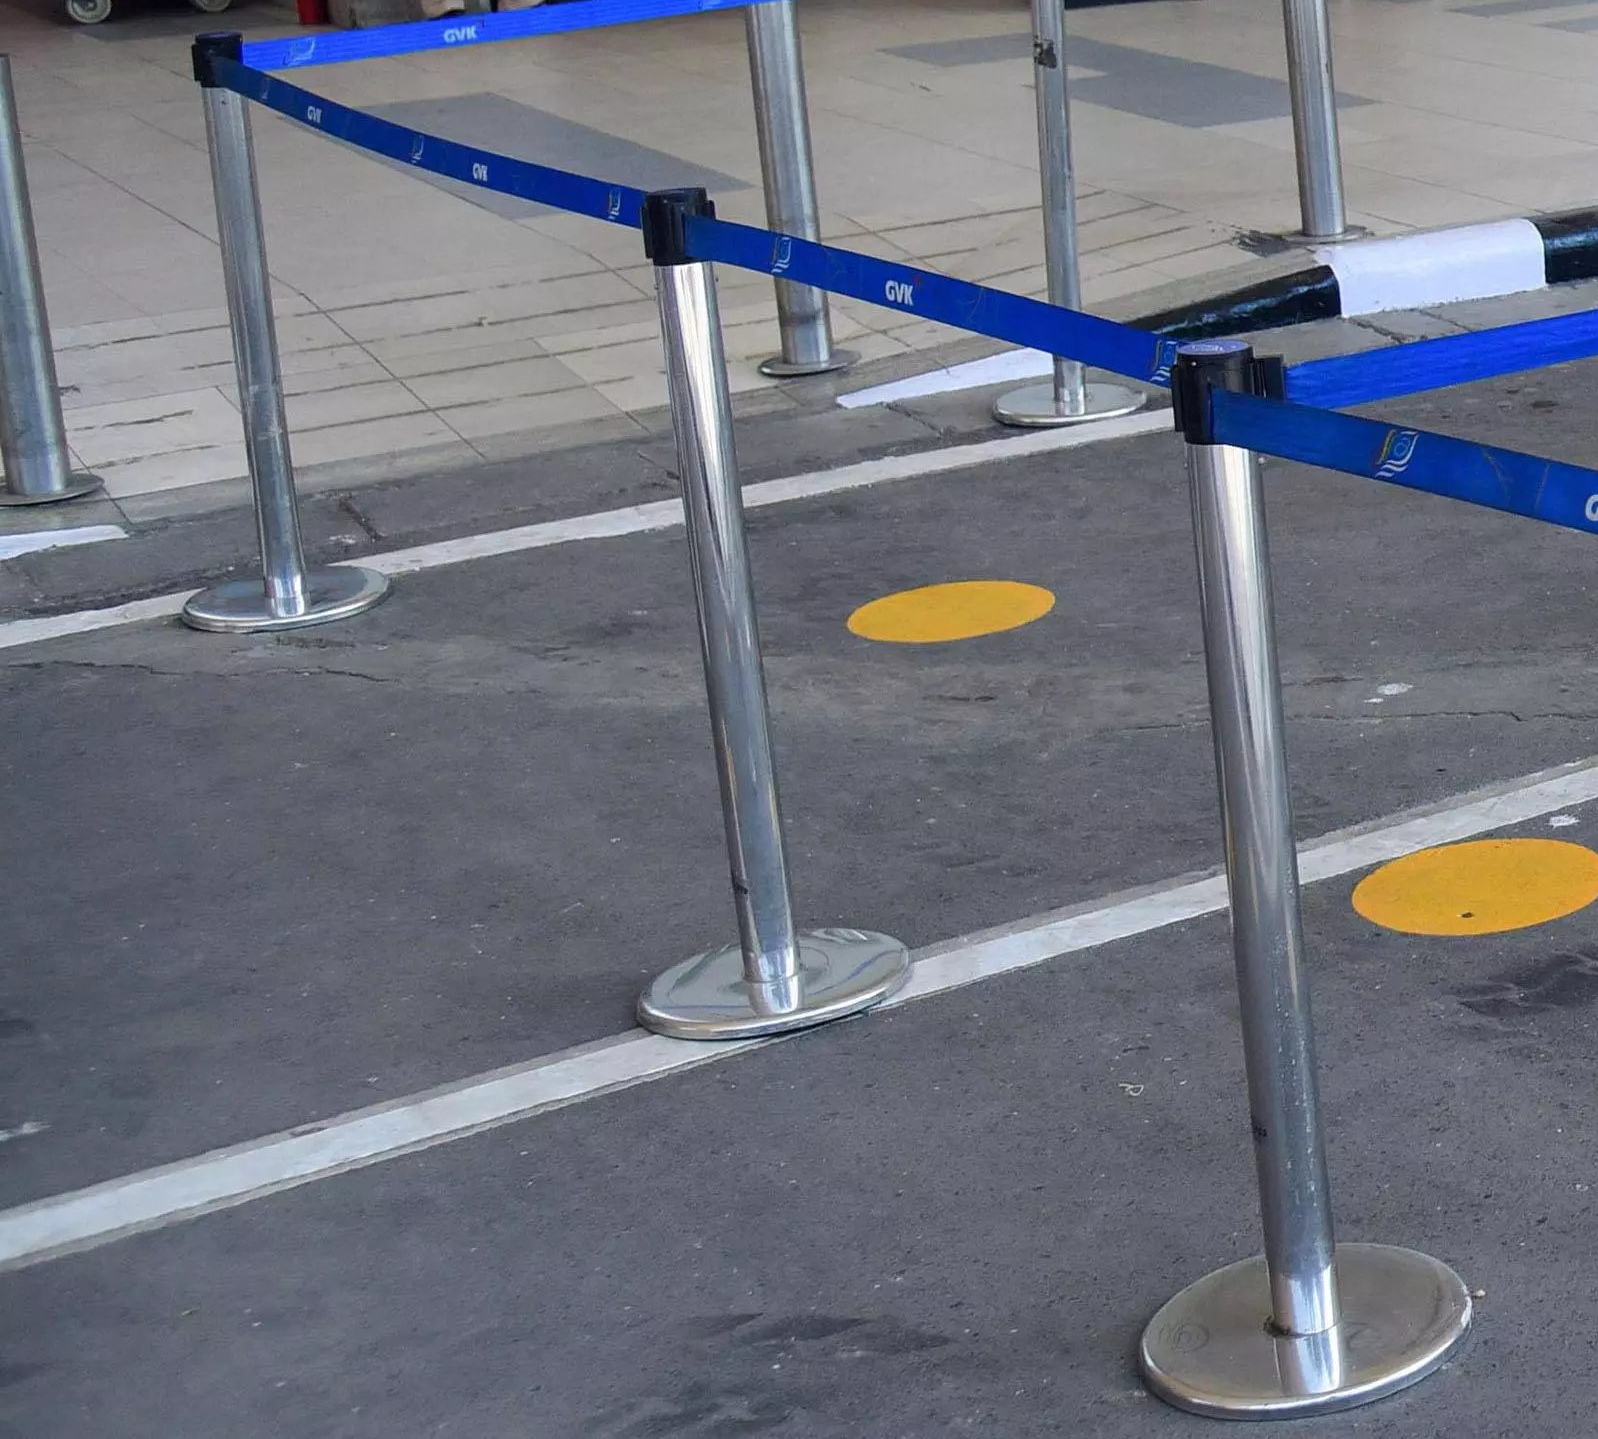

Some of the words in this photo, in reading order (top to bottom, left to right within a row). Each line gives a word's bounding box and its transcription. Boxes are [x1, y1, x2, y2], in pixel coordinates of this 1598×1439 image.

[443, 25, 477, 43] GVK
[307, 105, 322, 124] GVK
[473, 163, 488, 182] GVK
[885, 279, 915, 307] GVK
